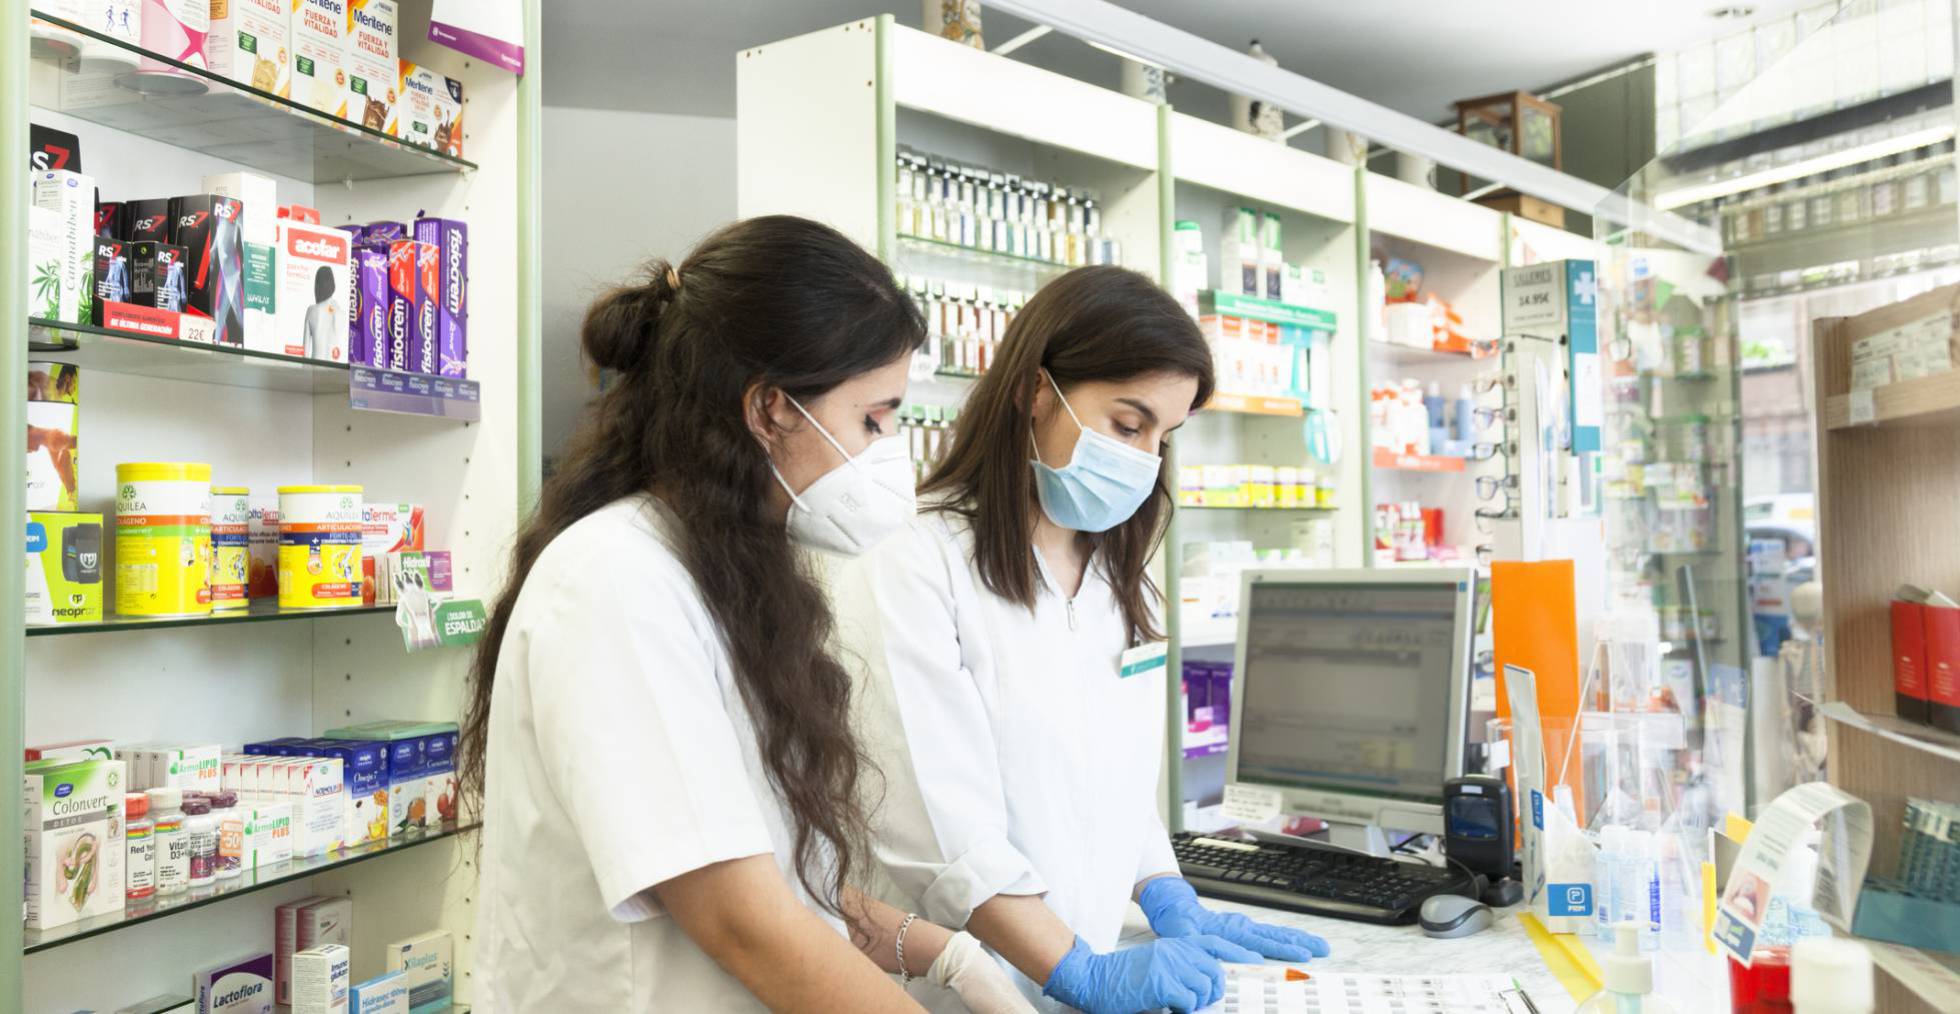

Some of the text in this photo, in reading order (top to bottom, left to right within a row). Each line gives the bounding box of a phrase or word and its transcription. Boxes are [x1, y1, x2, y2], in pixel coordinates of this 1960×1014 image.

[305, 9, 332, 26] FUERZA
[353, 9, 393, 36] Meritene
[303, 18, 338, 38] VITALIDAD
[357, 39, 390, 59] VITALIDAD
[358, 31, 384, 47] FUERZA
[31, 144, 70, 171] S7
[179, 211, 209, 229] RS7
[213, 201, 242, 224] RS7
[134, 214, 167, 233] RS7
[98, 243, 122, 260] RS7
[158, 249, 180, 266] RS7
[449, 228, 463, 314] fisiocrem
[373, 303, 384, 368] fisiocrem
[390, 296, 405, 371] fisiocrem
[421, 299, 434, 373] fisiocrem
[117, 501, 147, 513] QUILEA
[53, 795, 108, 816] Colonvert
[130, 845, 145, 855] Red
[213, 983, 263, 1009] Lactoflora
